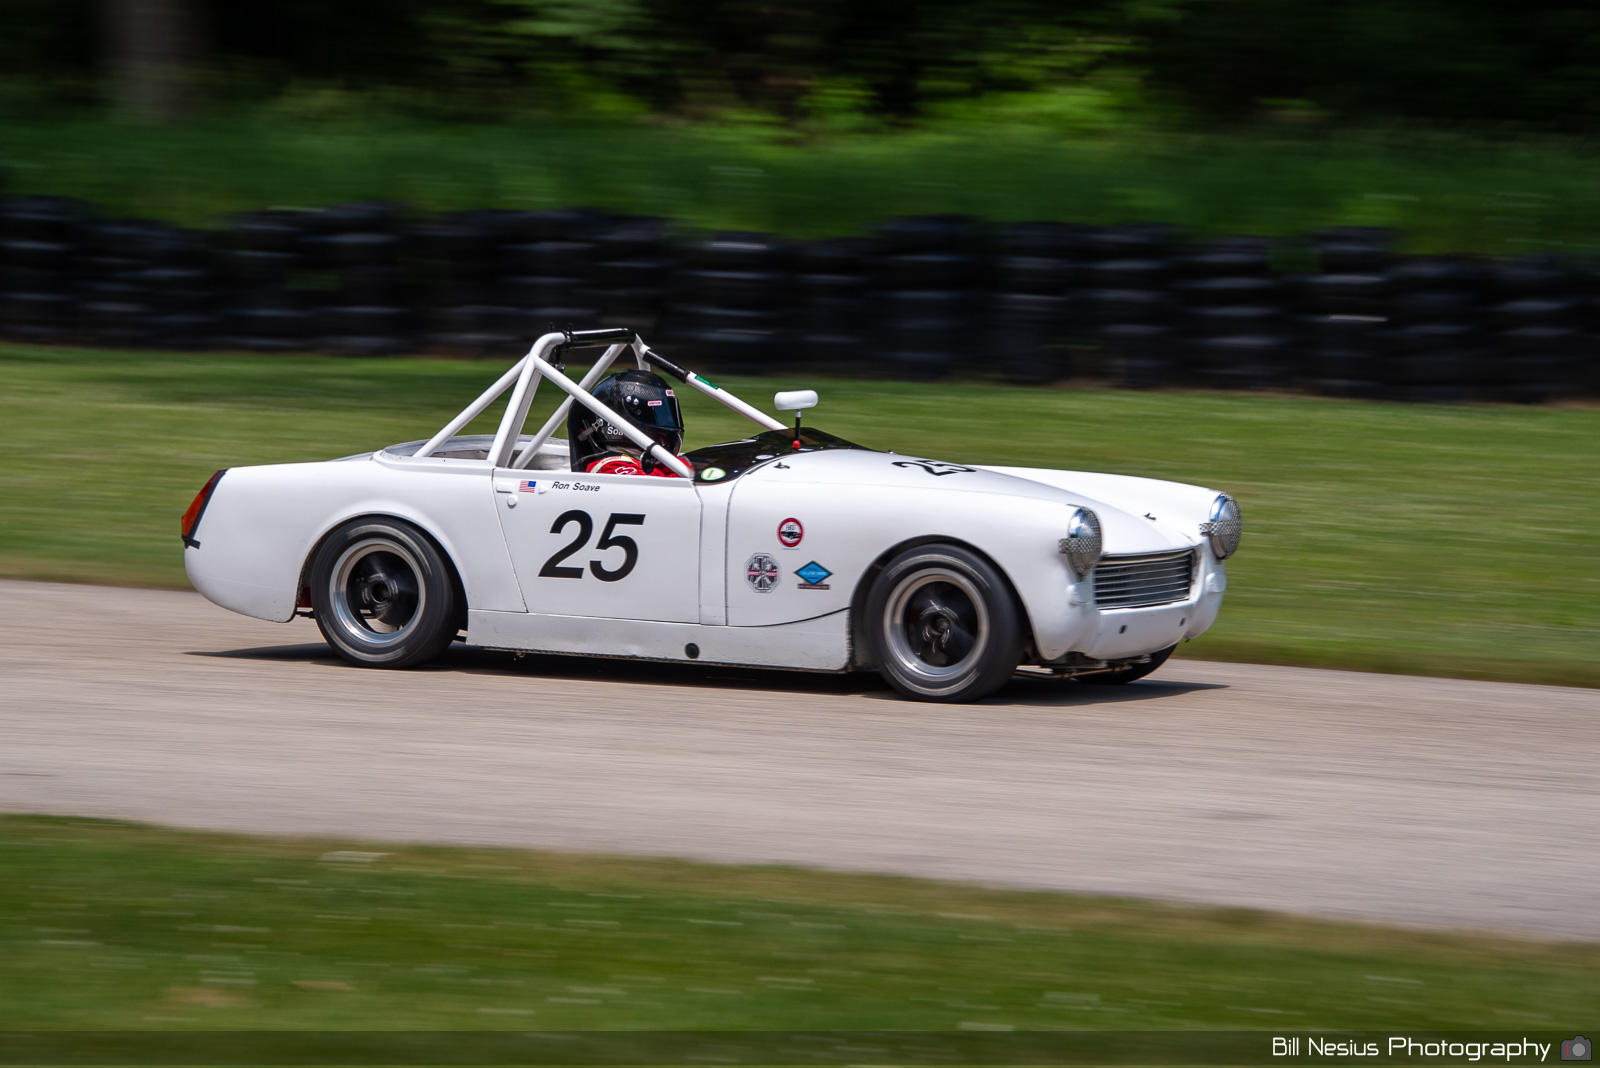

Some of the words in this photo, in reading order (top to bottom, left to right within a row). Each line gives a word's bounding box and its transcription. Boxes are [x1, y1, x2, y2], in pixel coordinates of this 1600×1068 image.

[551, 481, 570, 490] Ron
[572, 482, 601, 492] Soave
[538, 509, 646, 582] 25
